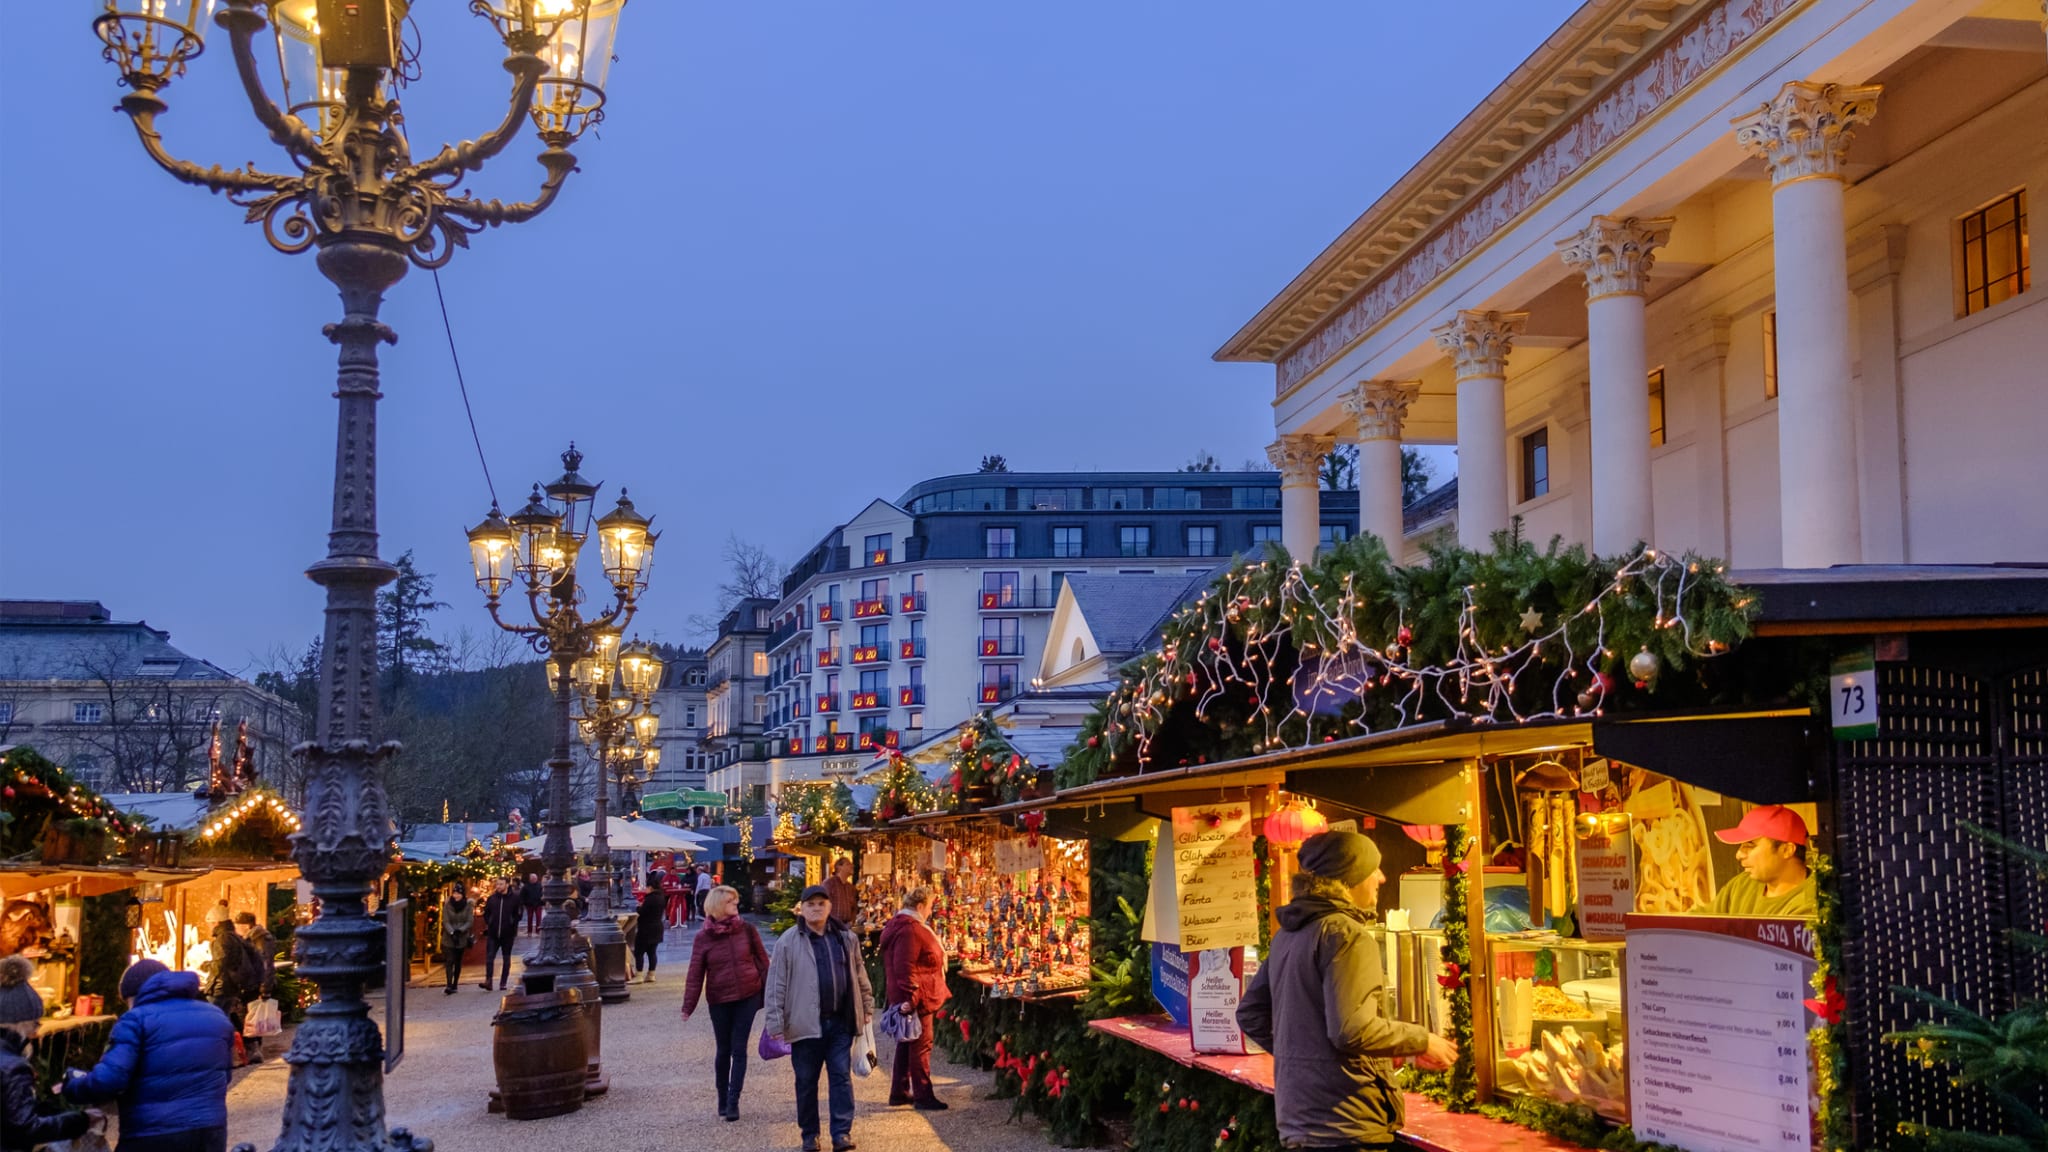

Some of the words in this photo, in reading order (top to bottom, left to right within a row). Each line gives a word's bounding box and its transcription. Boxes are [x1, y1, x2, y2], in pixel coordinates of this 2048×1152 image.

[904, 600, 912, 609] 4
[986, 597, 993, 606] 7
[904, 646, 912, 656] 2
[987, 643, 994, 654] 9
[866, 650, 877, 660] 20
[986, 690, 995, 700] 11
[1841, 685, 1865, 716] 73
[820, 700, 828, 710] 6
[836, 738, 846, 749] 23
[1182, 874, 1204, 885] Cola
[1612, 878, 1630, 892] 5,00
[1182, 894, 1212, 906] Fanta
[1183, 914, 1222, 926] Wasser
[1186, 934, 1208, 946] Bier
[1757, 924, 1789, 946] ASIA
[1206, 976, 1224, 984] Heißer
[1641, 978, 1658, 986] Nudeln
[1224, 997, 1236, 1006] 5,00
[1642, 1002, 1652, 1010] Thai
[1652, 1004, 1666, 1014] Curry
[1226, 1034, 1238, 1042] 5,00
[1644, 1052, 1670, 1063] Gebackene
[1671, 1056, 1682, 1065] Ente
[1644, 1077, 1663, 1088] Chicken
[1664, 1082, 1693, 1094] McNuggets
[1646, 1128, 1655, 1136] Mix
[1656, 1129, 1666, 1138] Box
